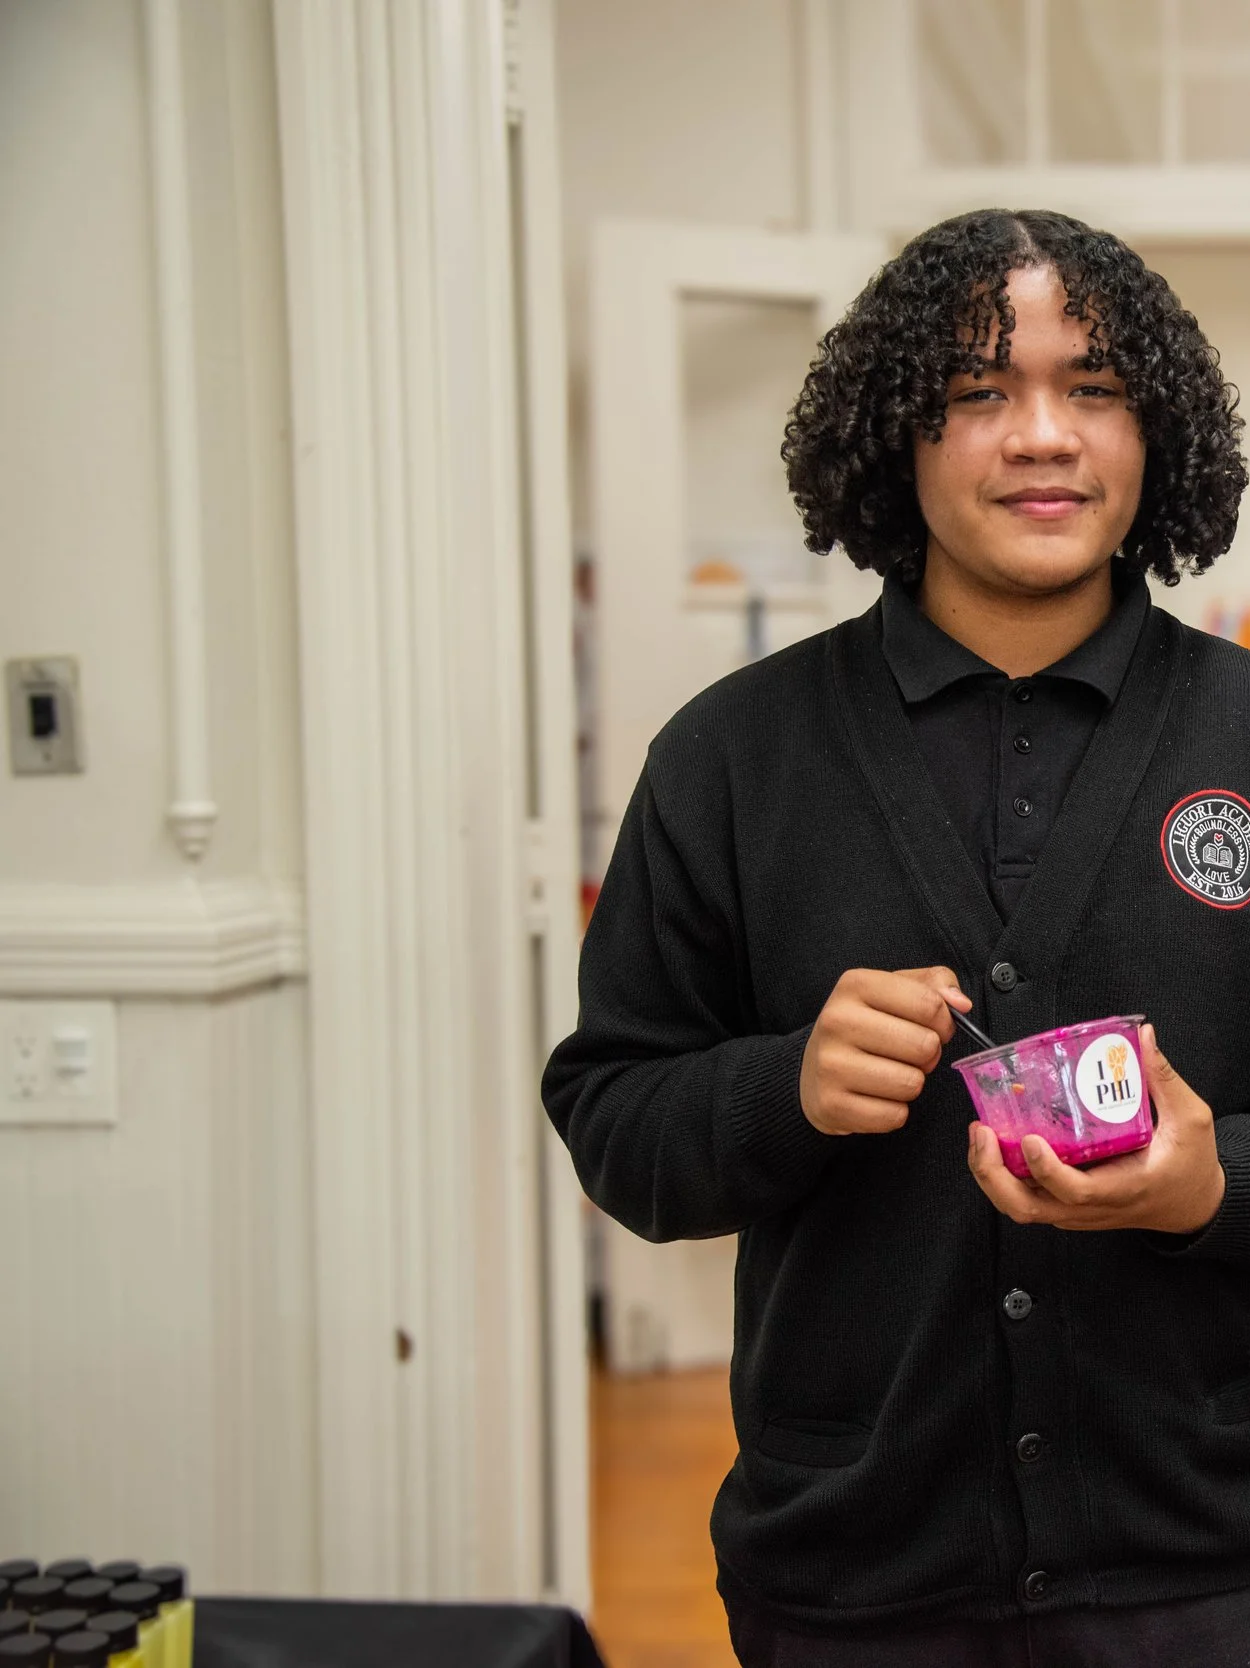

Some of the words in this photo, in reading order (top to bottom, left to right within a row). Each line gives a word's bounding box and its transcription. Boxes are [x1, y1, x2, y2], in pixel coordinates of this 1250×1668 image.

[1173, 803, 1213, 846] LIGUORI
[1195, 820, 1242, 845] BOUNDLESS
[1186, 871, 1216, 896] EST.
[1221, 882, 1244, 898] 2016
[1205, 867, 1230, 882] LOVE
[1097, 1060, 1104, 1080] I
[1096, 1079, 1136, 1105] PHL
